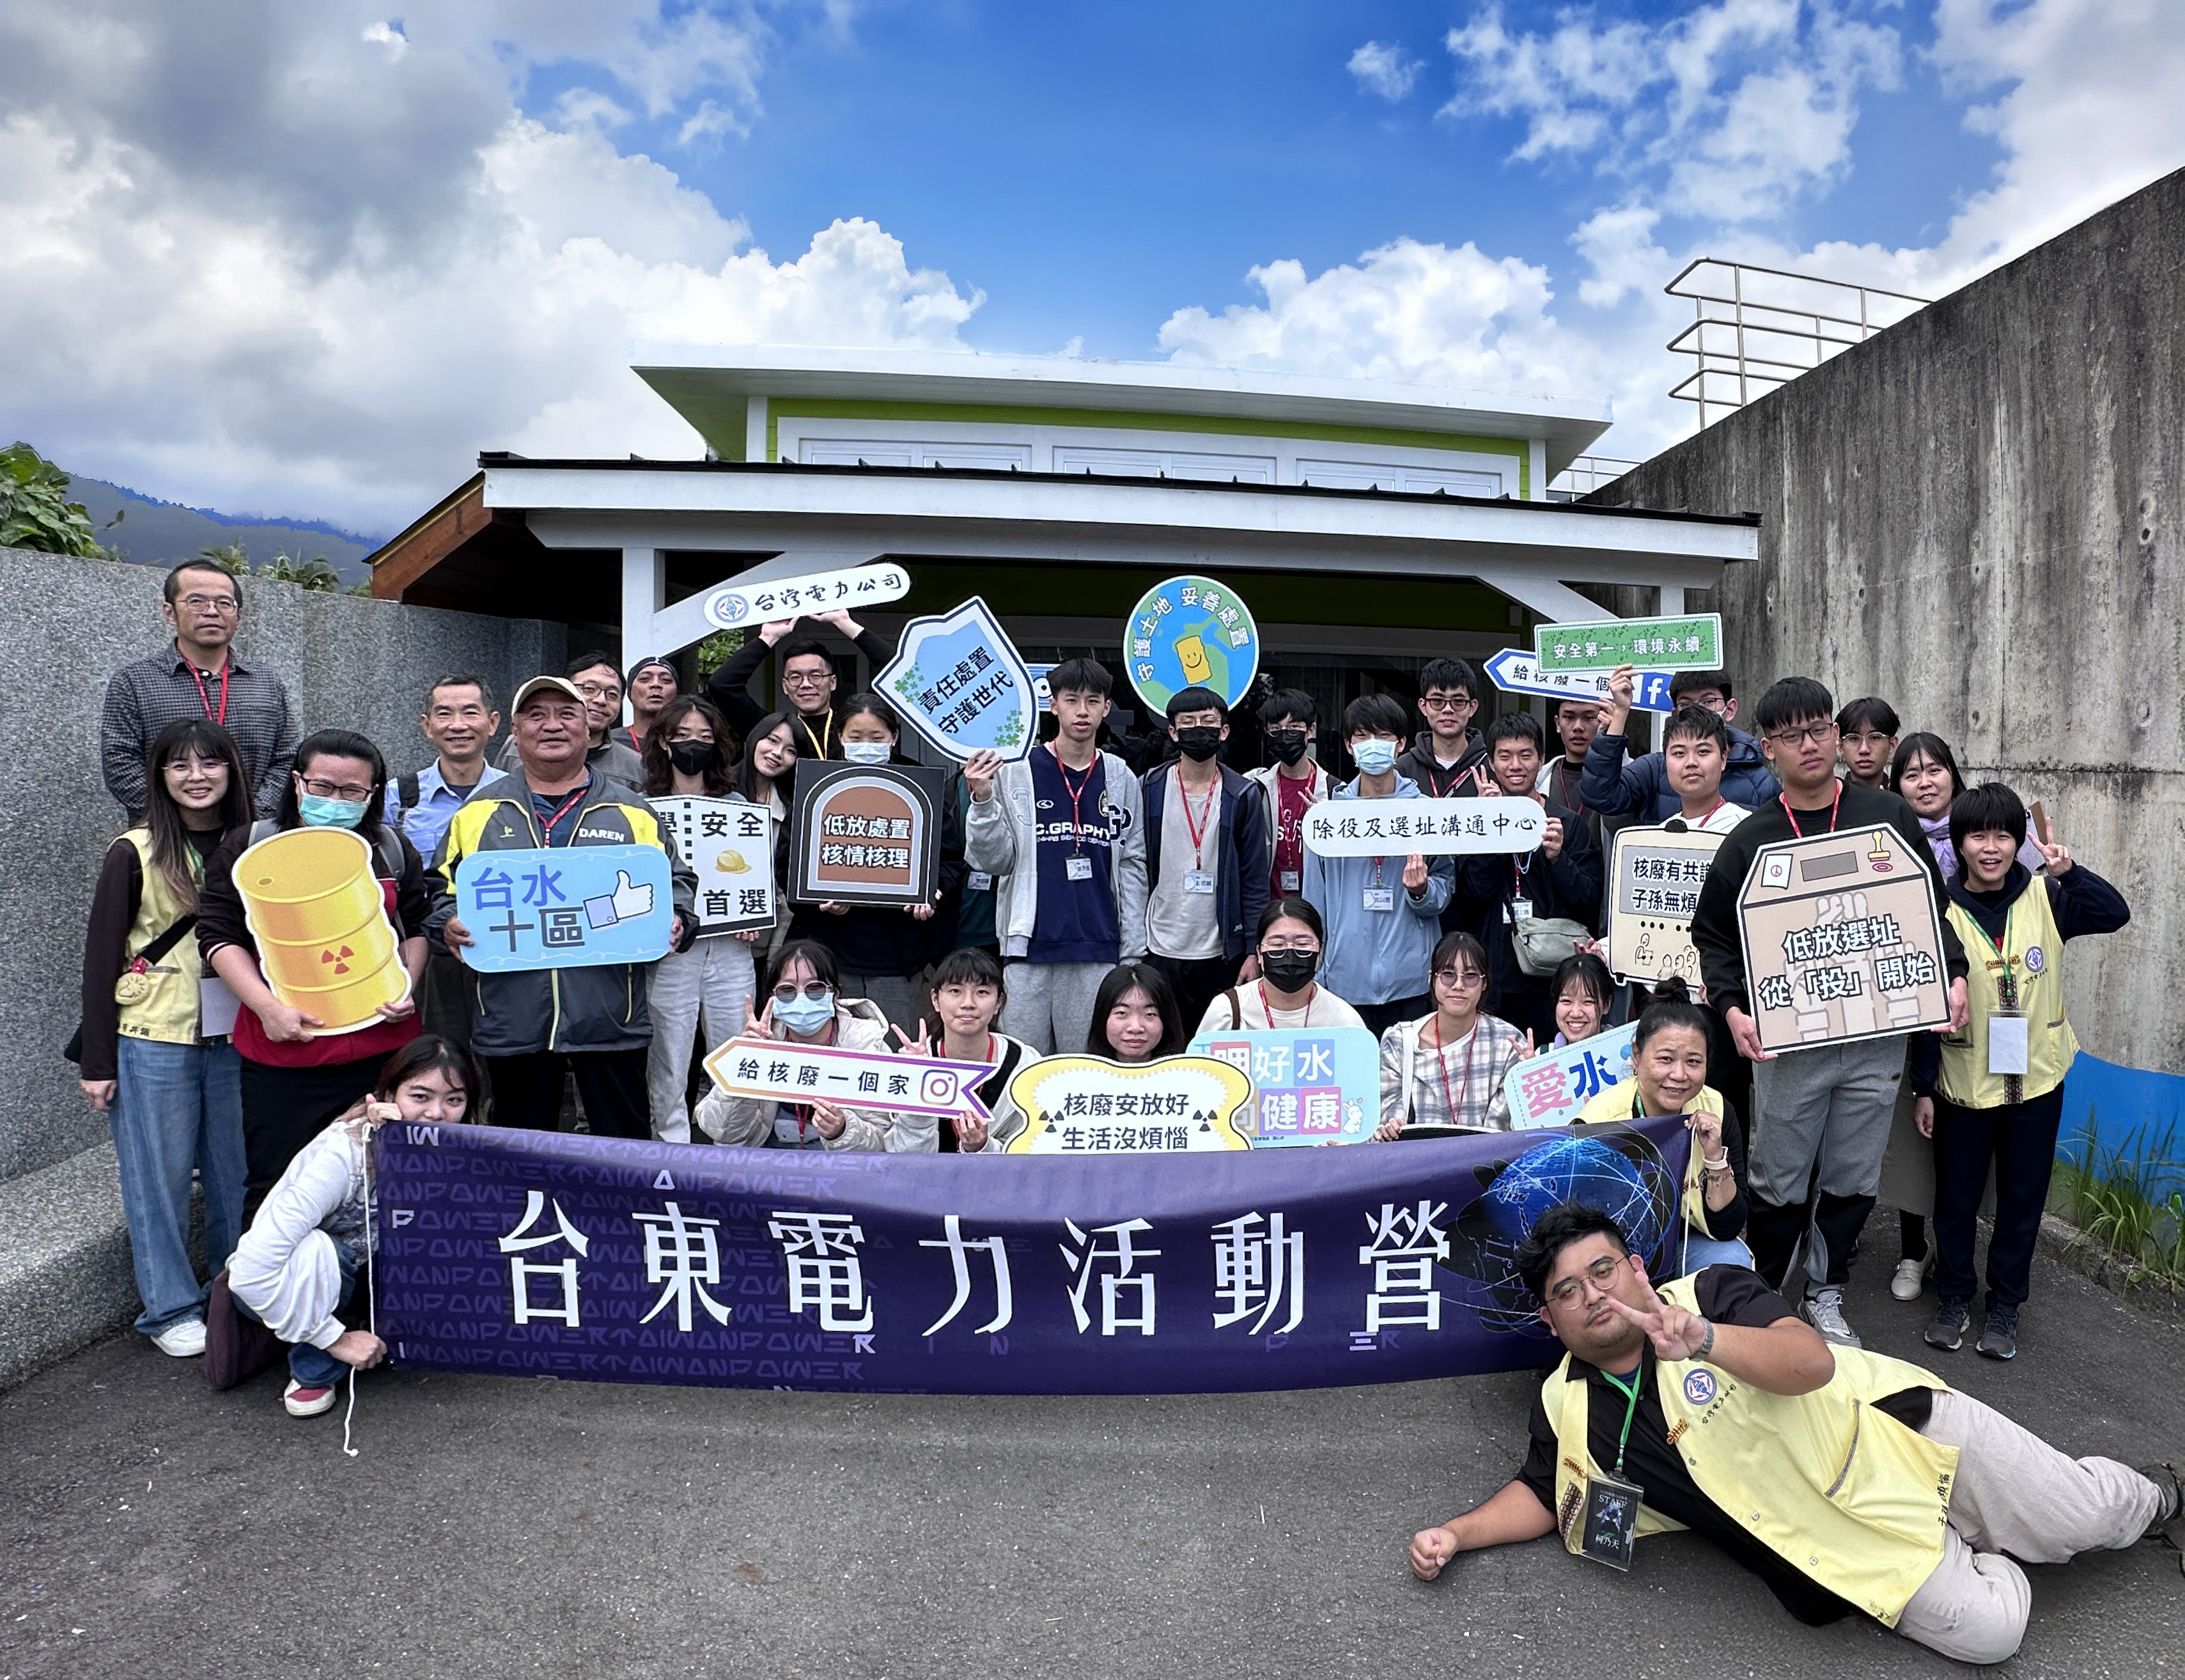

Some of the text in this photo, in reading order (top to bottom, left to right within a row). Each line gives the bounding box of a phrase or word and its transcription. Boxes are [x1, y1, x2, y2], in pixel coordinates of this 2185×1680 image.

[1133, 586, 1250, 683] 守護土地 妥善處置
[917, 646, 995, 715] 責任處置
[936, 671, 1015, 736] 守護世代
[579, 828, 625, 843] DAREN
[701, 810, 765, 839] 安全
[823, 814, 911, 841] 低放處置
[1312, 812, 1537, 841] 除役及選址溝通中心
[821, 843, 910, 869] 核情核理
[470, 864, 566, 910] 台水
[703, 888, 767, 917] 首選
[489, 906, 586, 953] 十區
[1782, 915, 1901, 964] 低放選址
[736, 1057, 910, 1096] 給核廢一個家
[1063, 1092, 1190, 1117] 核廢安放好
[1061, 1126, 1189, 1151] 生活沒煩惱
[497, 1190, 1450, 1337] 台東電力活動營
[1598, 1494, 1628, 1509] STAFF
